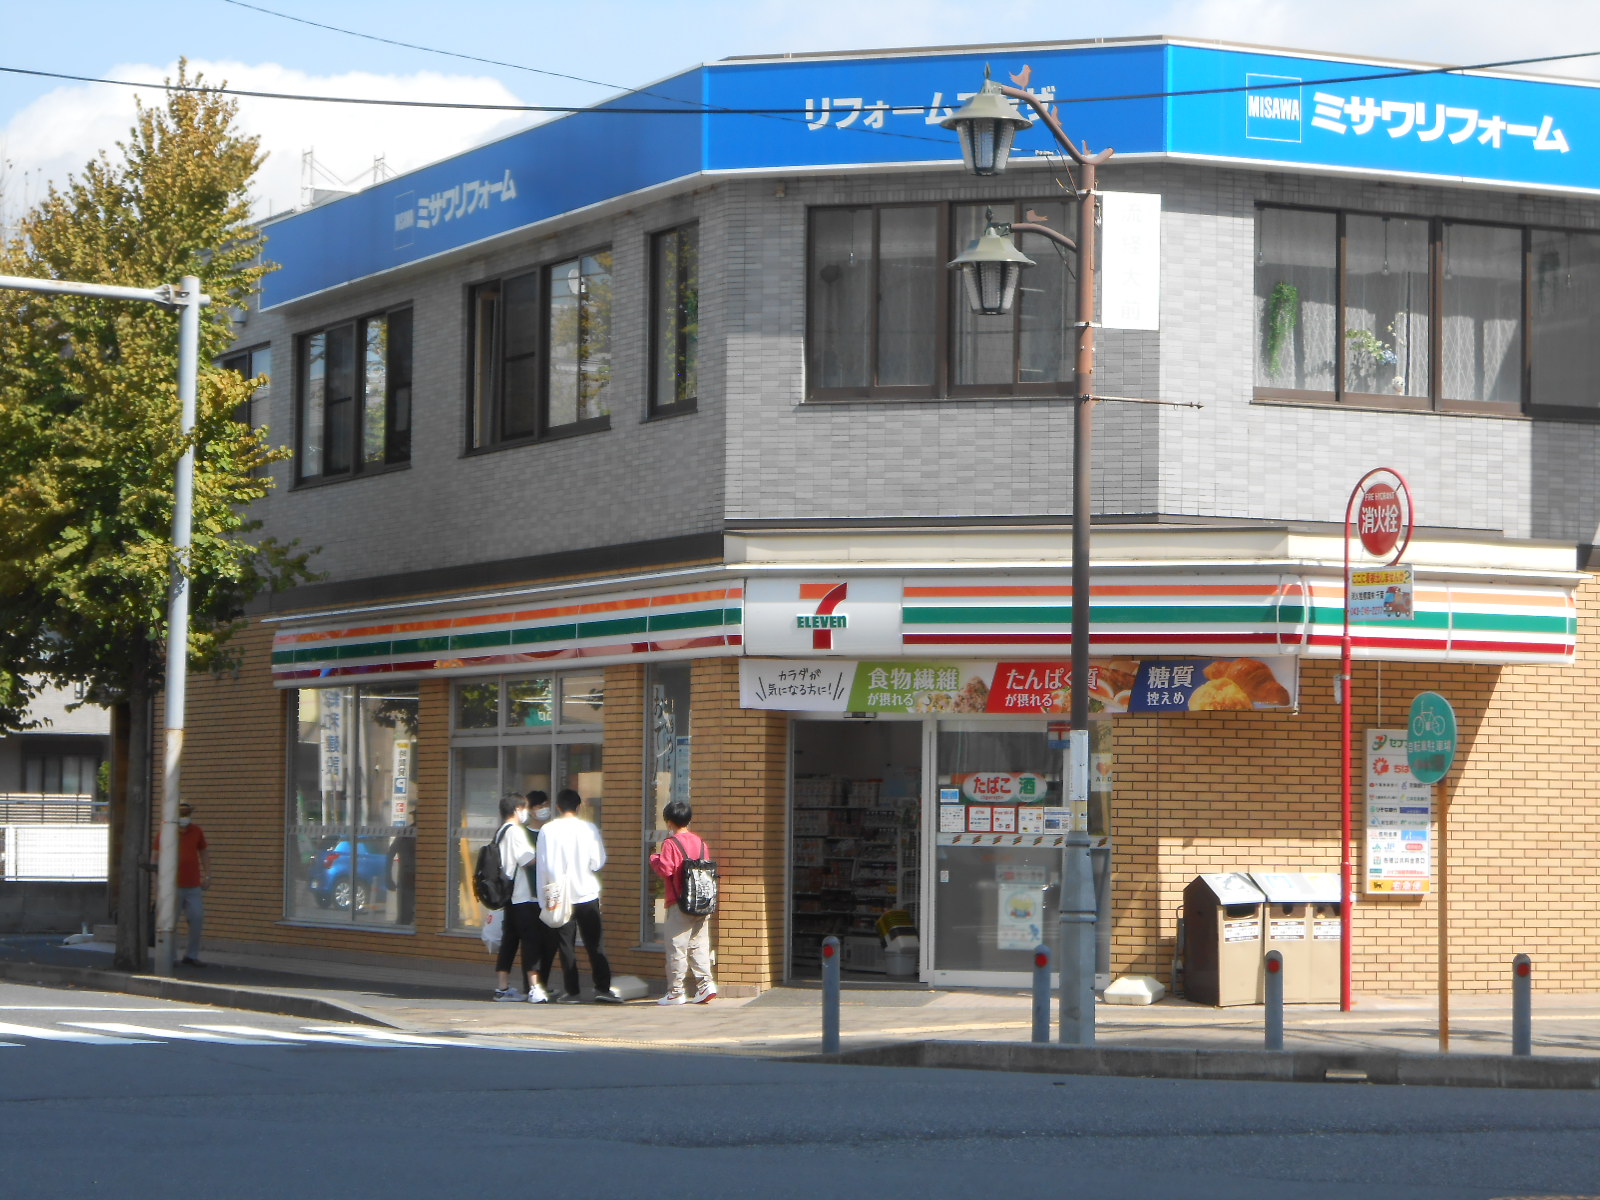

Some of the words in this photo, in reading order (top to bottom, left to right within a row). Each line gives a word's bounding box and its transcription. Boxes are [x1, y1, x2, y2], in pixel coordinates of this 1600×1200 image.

[805, 86, 1056, 131] リフォームザ
[1248, 95, 1299, 120] MISAWA
[1311, 92, 1570, 153] ミサワリフォーム
[416, 169, 517, 229] ミサワリフォーム
[1365, 493, 1374, 502] FIRE
[1361, 504, 1399, 534] 消火栓
[799, 582, 847, 650] 7
[779, 668, 822, 681] カラダが
[868, 667, 960, 691] 食物繊維
[1148, 666, 1194, 689] 糖質
[867, 693, 914, 707] が摂れる
[1005, 693, 1053, 707] が摂れる
[1147, 692, 1185, 706] 控えめ
[973, 777, 1012, 794] たばこ
[1019, 777, 1036, 794] 酒
